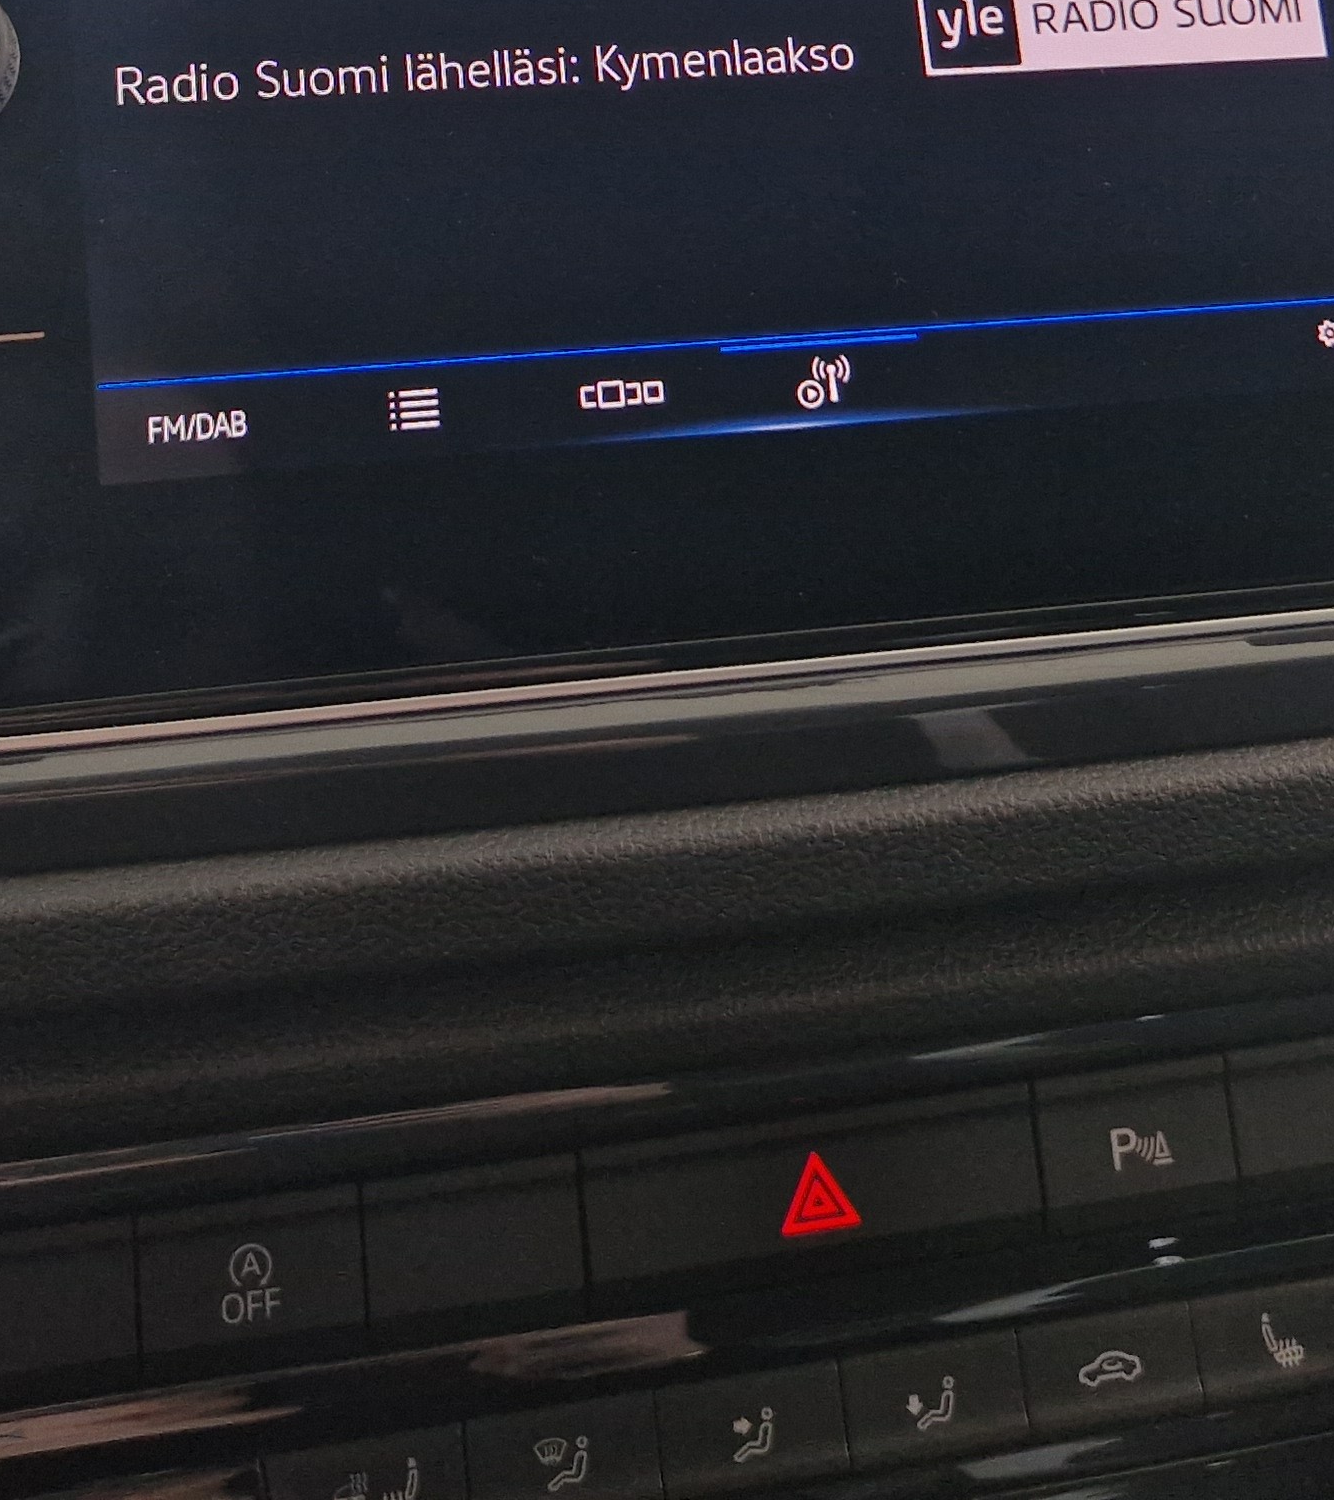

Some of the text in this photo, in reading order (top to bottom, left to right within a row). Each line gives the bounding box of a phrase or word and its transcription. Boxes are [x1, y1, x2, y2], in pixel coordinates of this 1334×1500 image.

[116, 36, 855, 106] Radio Suomi lähelläsi: Kymenlaakso
[147, 409, 248, 444] FM/DAB
[1110, 1127, 1138, 1171] P
[221, 1287, 281, 1324] OFF
